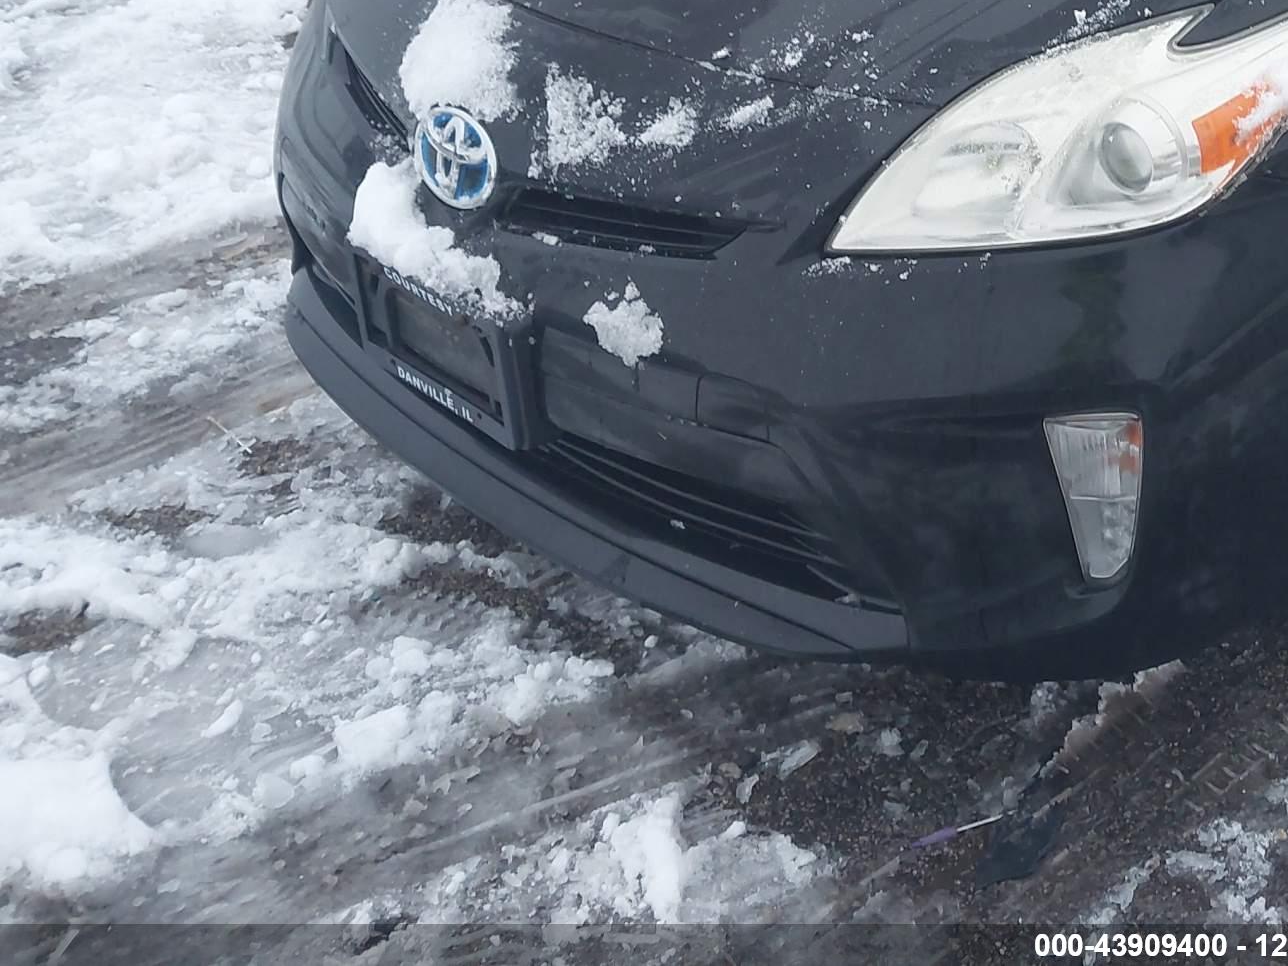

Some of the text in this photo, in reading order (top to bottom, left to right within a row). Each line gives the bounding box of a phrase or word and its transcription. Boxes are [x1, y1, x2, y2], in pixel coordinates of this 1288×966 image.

[383, 266, 454, 317] COURTESY
[396, 364, 474, 423] DANVILLE, IL
